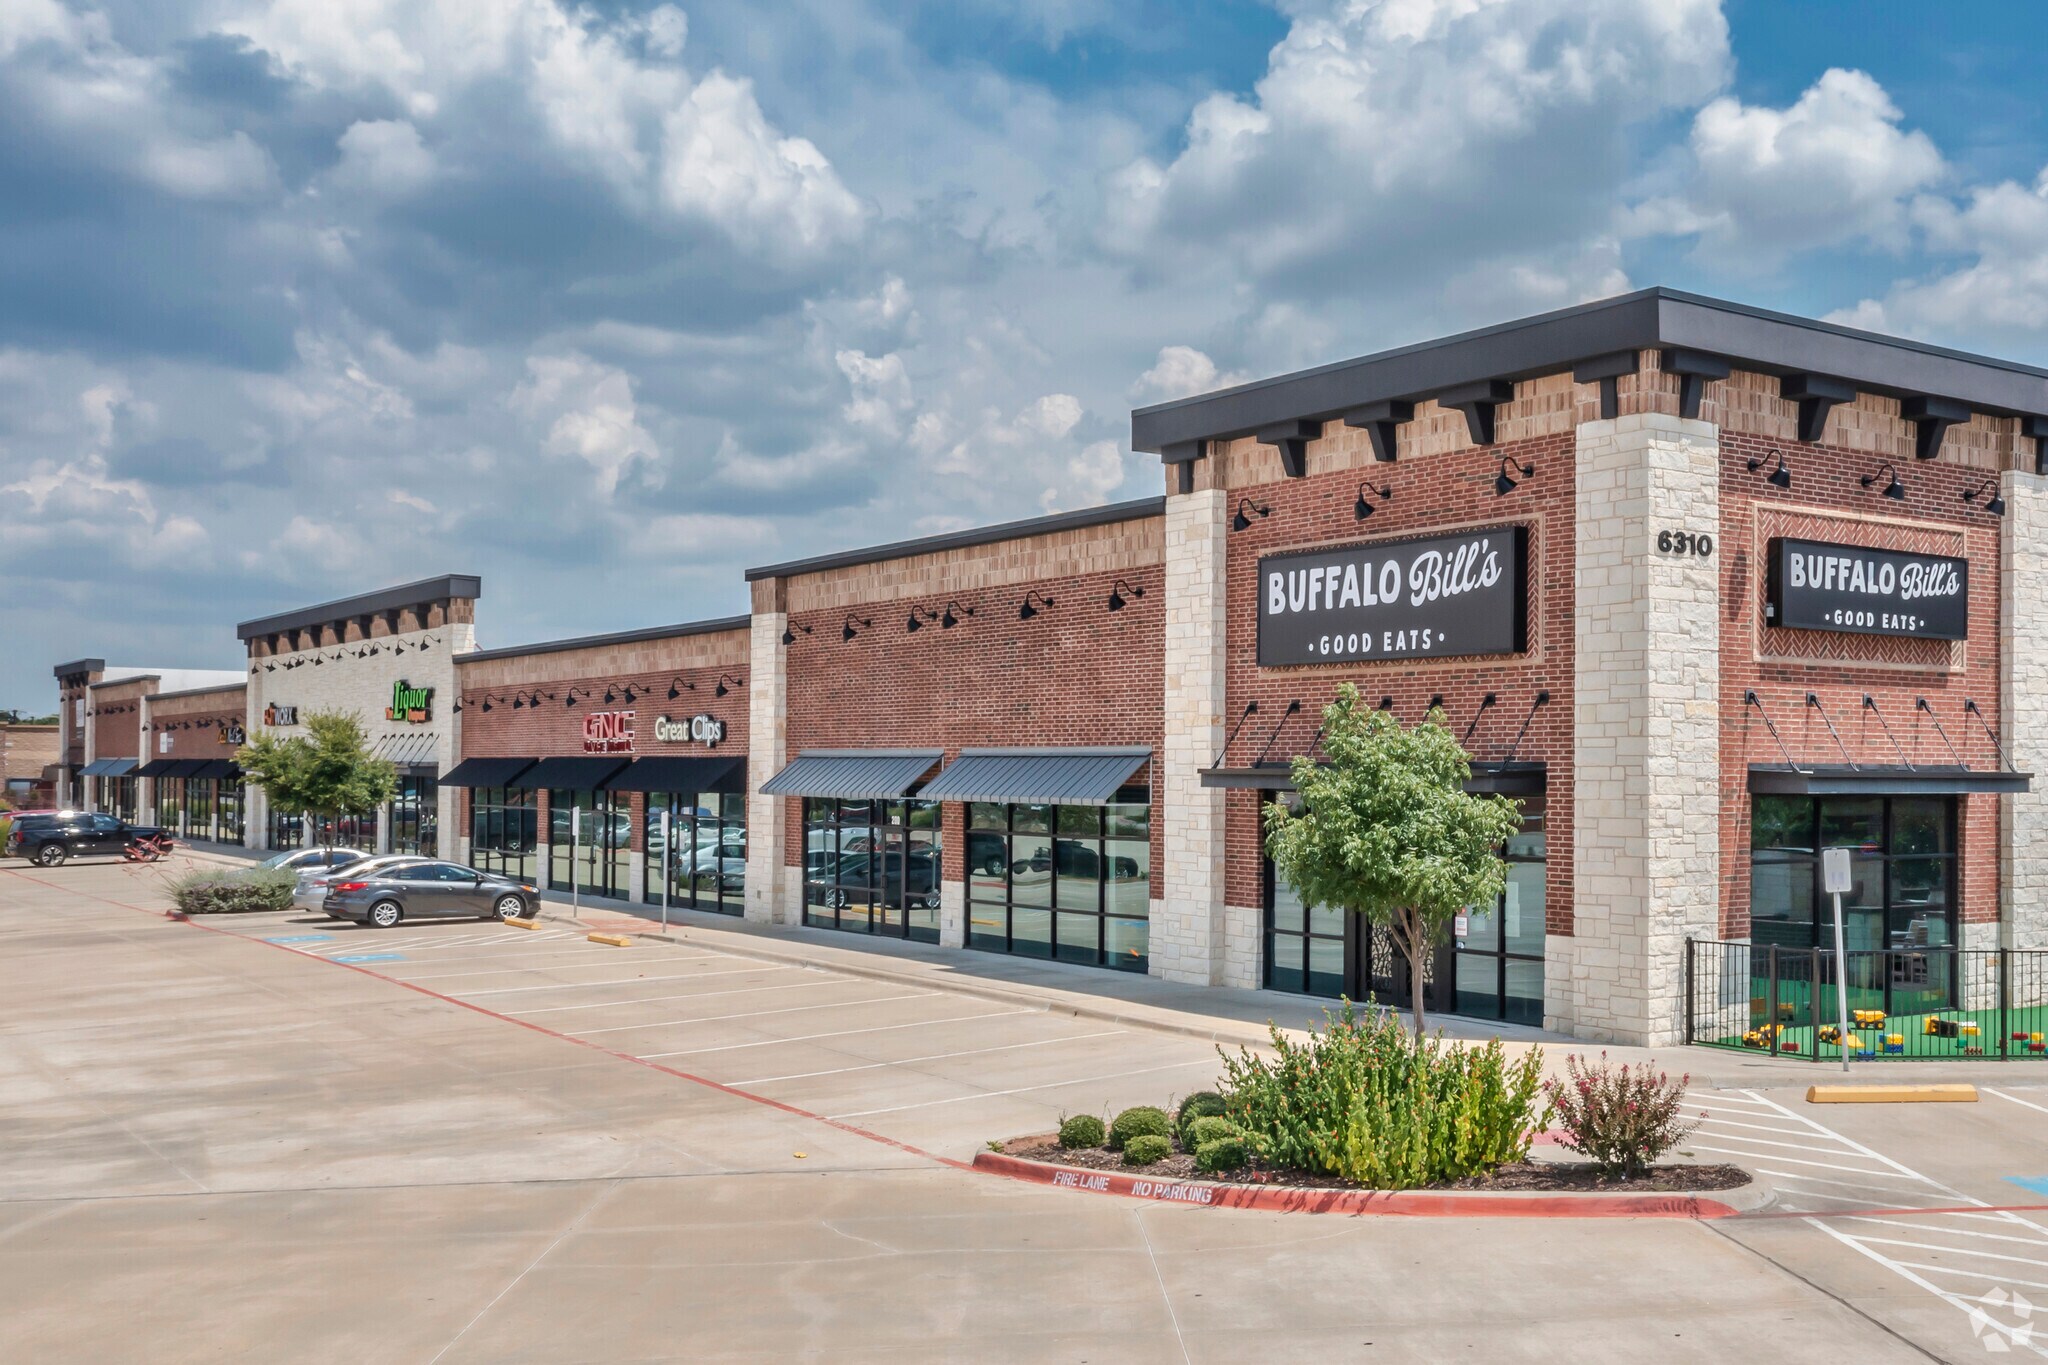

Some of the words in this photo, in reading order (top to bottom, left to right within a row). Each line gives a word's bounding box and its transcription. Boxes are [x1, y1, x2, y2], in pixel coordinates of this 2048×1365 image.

[1657, 530, 1713, 556] 6310
[1268, 559, 1401, 615] BUFFALO
[1408, 538, 1502, 607] Bill's
[1790, 552, 1896, 595] BUFFALO
[1900, 562, 1960, 600] Bill's
[1834, 609, 1875, 627] GOOD
[1882, 613, 1916, 631] EATS
[1320, 632, 1372, 655] GOOD
[1383, 628, 1432, 652] EATS
[393, 681, 428, 721] Liquor
[582, 711, 636, 740] GNC
[654, 716, 690, 741] Great
[691, 715, 721, 748] Clips
[1053, 1171, 1078, 1186] FIRE
[1079, 1175, 1110, 1191] LANE
[1131, 1181, 1152, 1196] NO
[1153, 1183, 1212, 1203] PARKING
